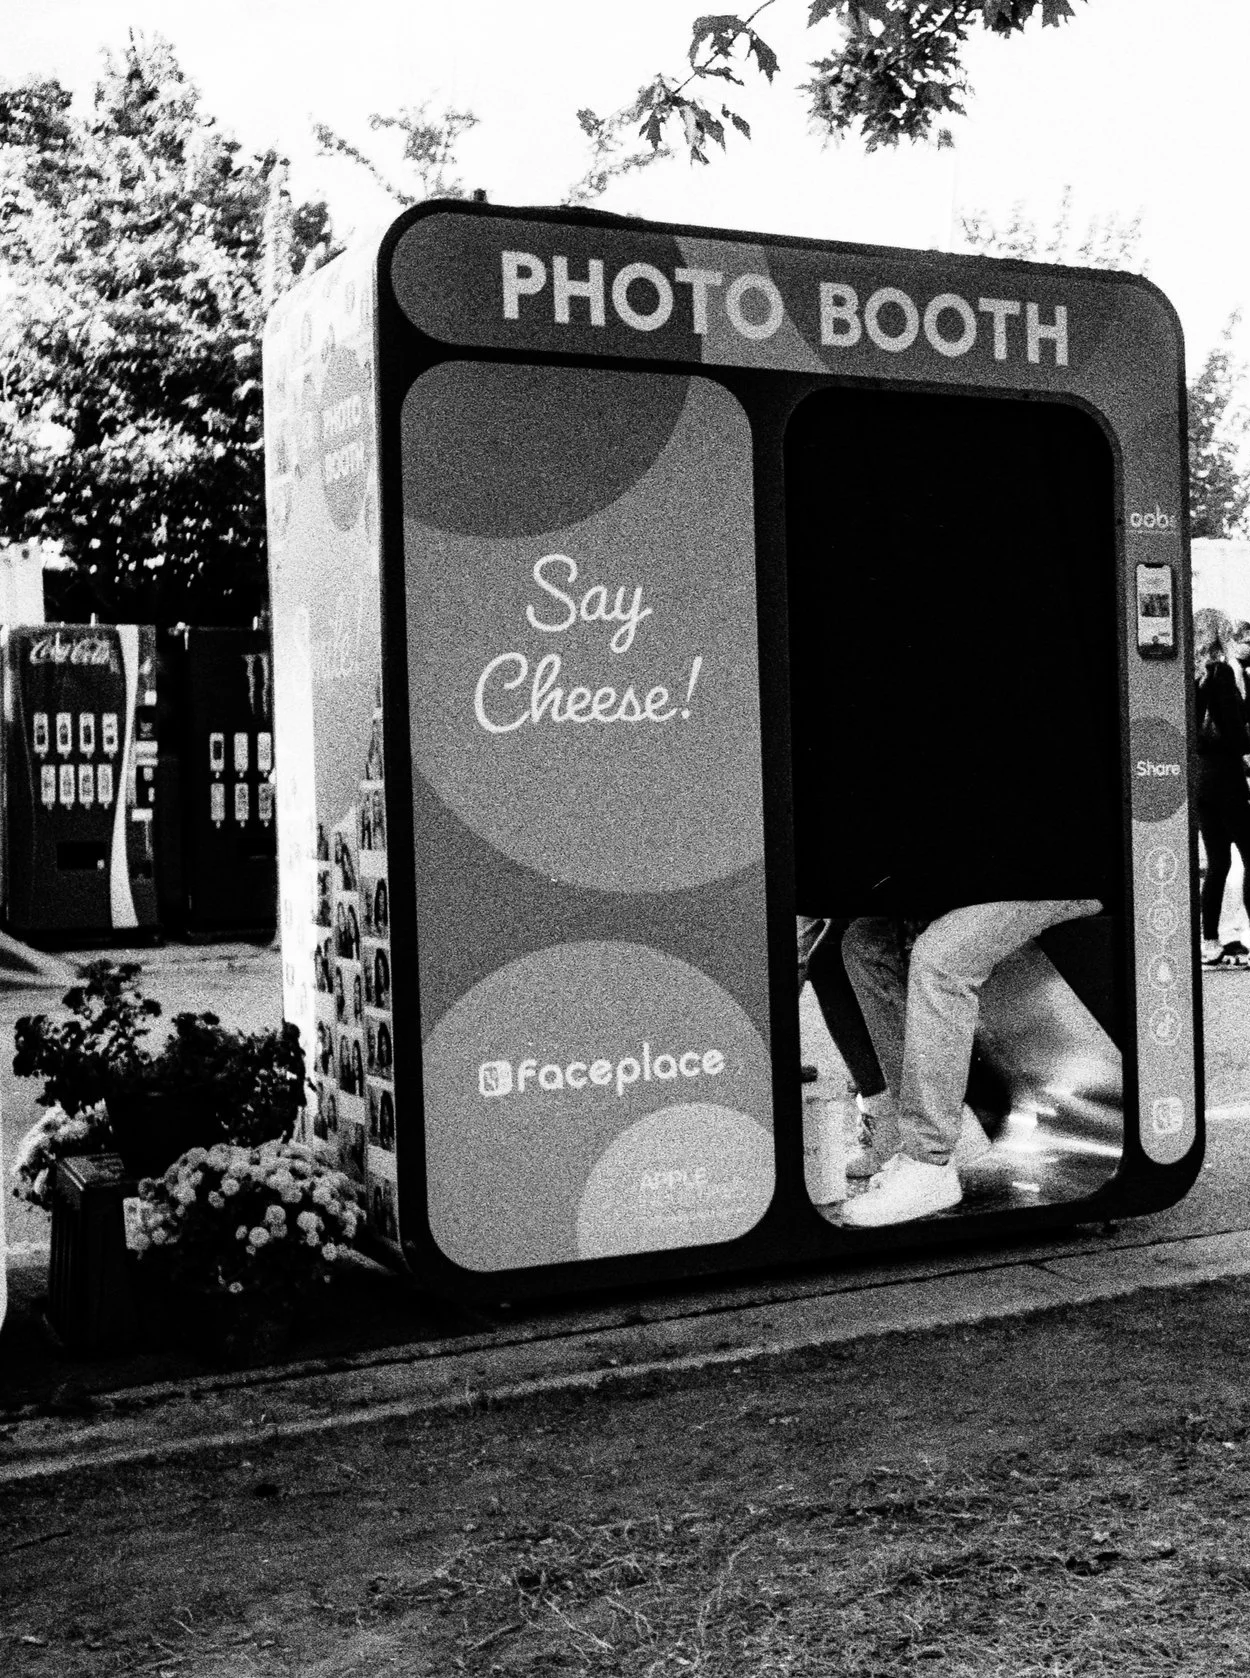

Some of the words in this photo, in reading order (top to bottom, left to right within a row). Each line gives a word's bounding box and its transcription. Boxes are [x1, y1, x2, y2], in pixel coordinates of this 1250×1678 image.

[500, 249, 785, 340] PHOTO
[819, 282, 1070, 367] BOOTH
[526, 554, 654, 655] Say
[474, 652, 704, 734] Cheese!
[1135, 759, 1181, 778] Share
[518, 1042, 725, 1096] faceplace
[640, 1166, 709, 1189] APPLE
